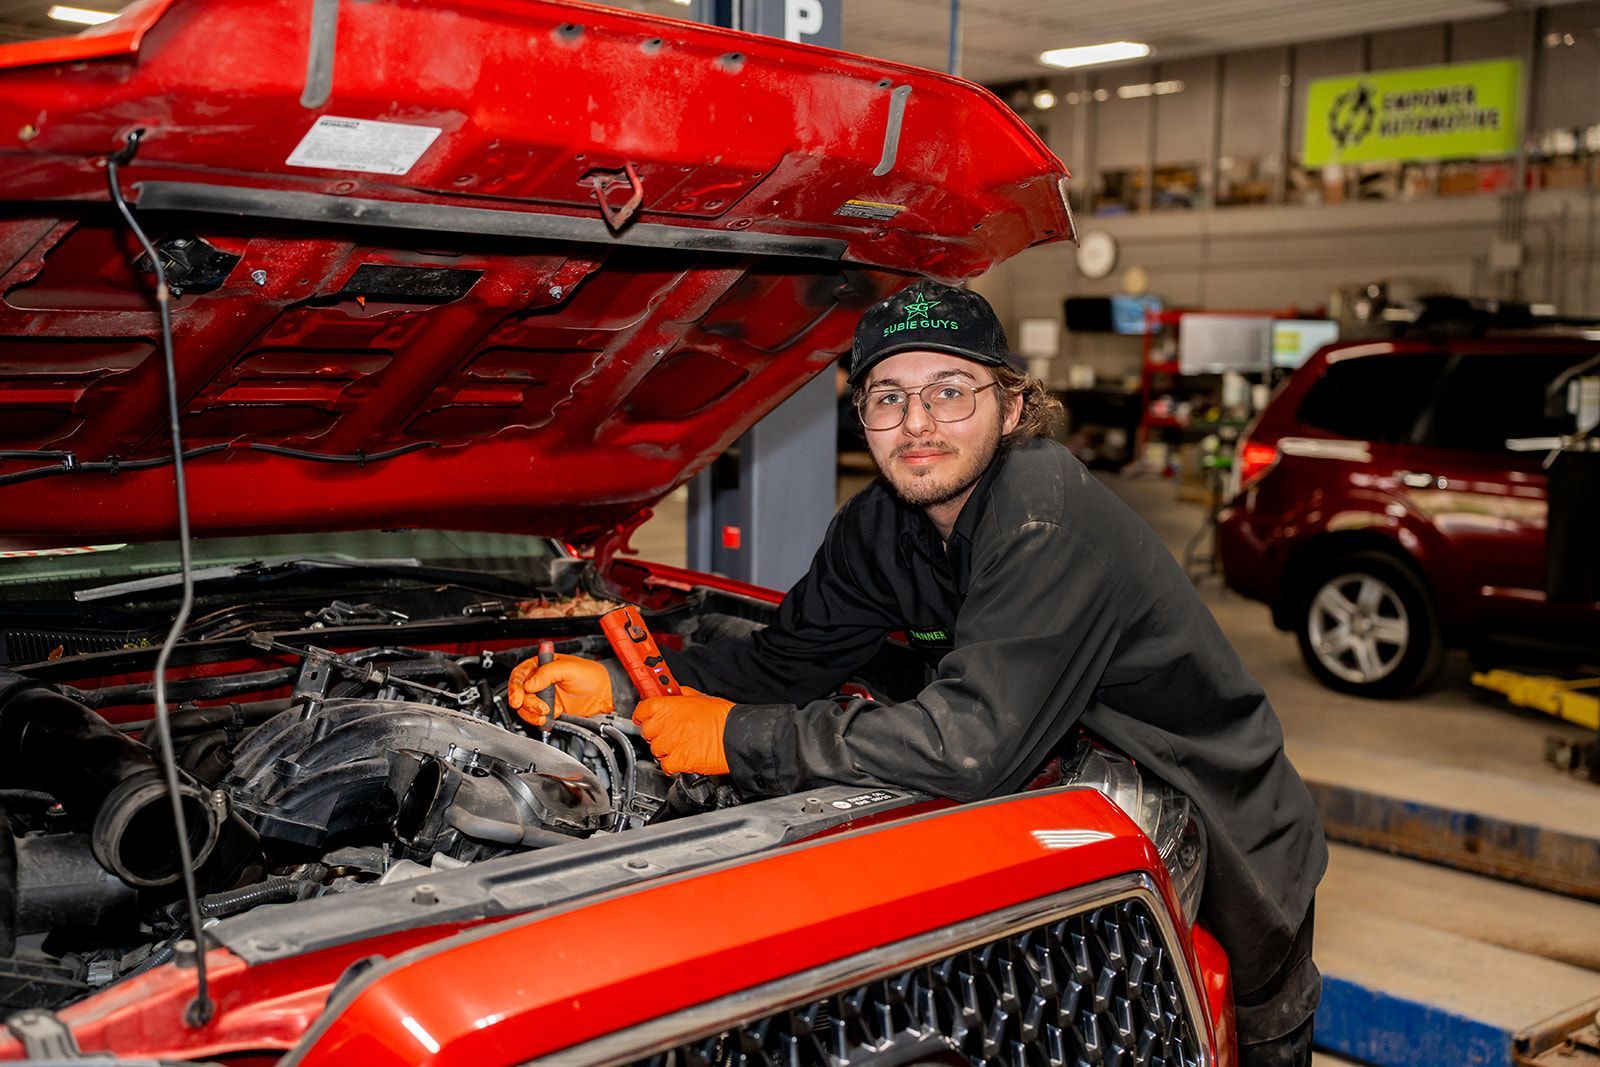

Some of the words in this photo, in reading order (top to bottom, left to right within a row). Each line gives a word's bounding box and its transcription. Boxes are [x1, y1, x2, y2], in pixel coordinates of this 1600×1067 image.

[785, 0, 823, 43] P
[1383, 85, 1476, 110] EMPOWER
[1380, 109, 1500, 136] AUTOMOTIVE
[883, 320, 918, 337] SUBIE
[920, 319, 959, 330] GUYS
